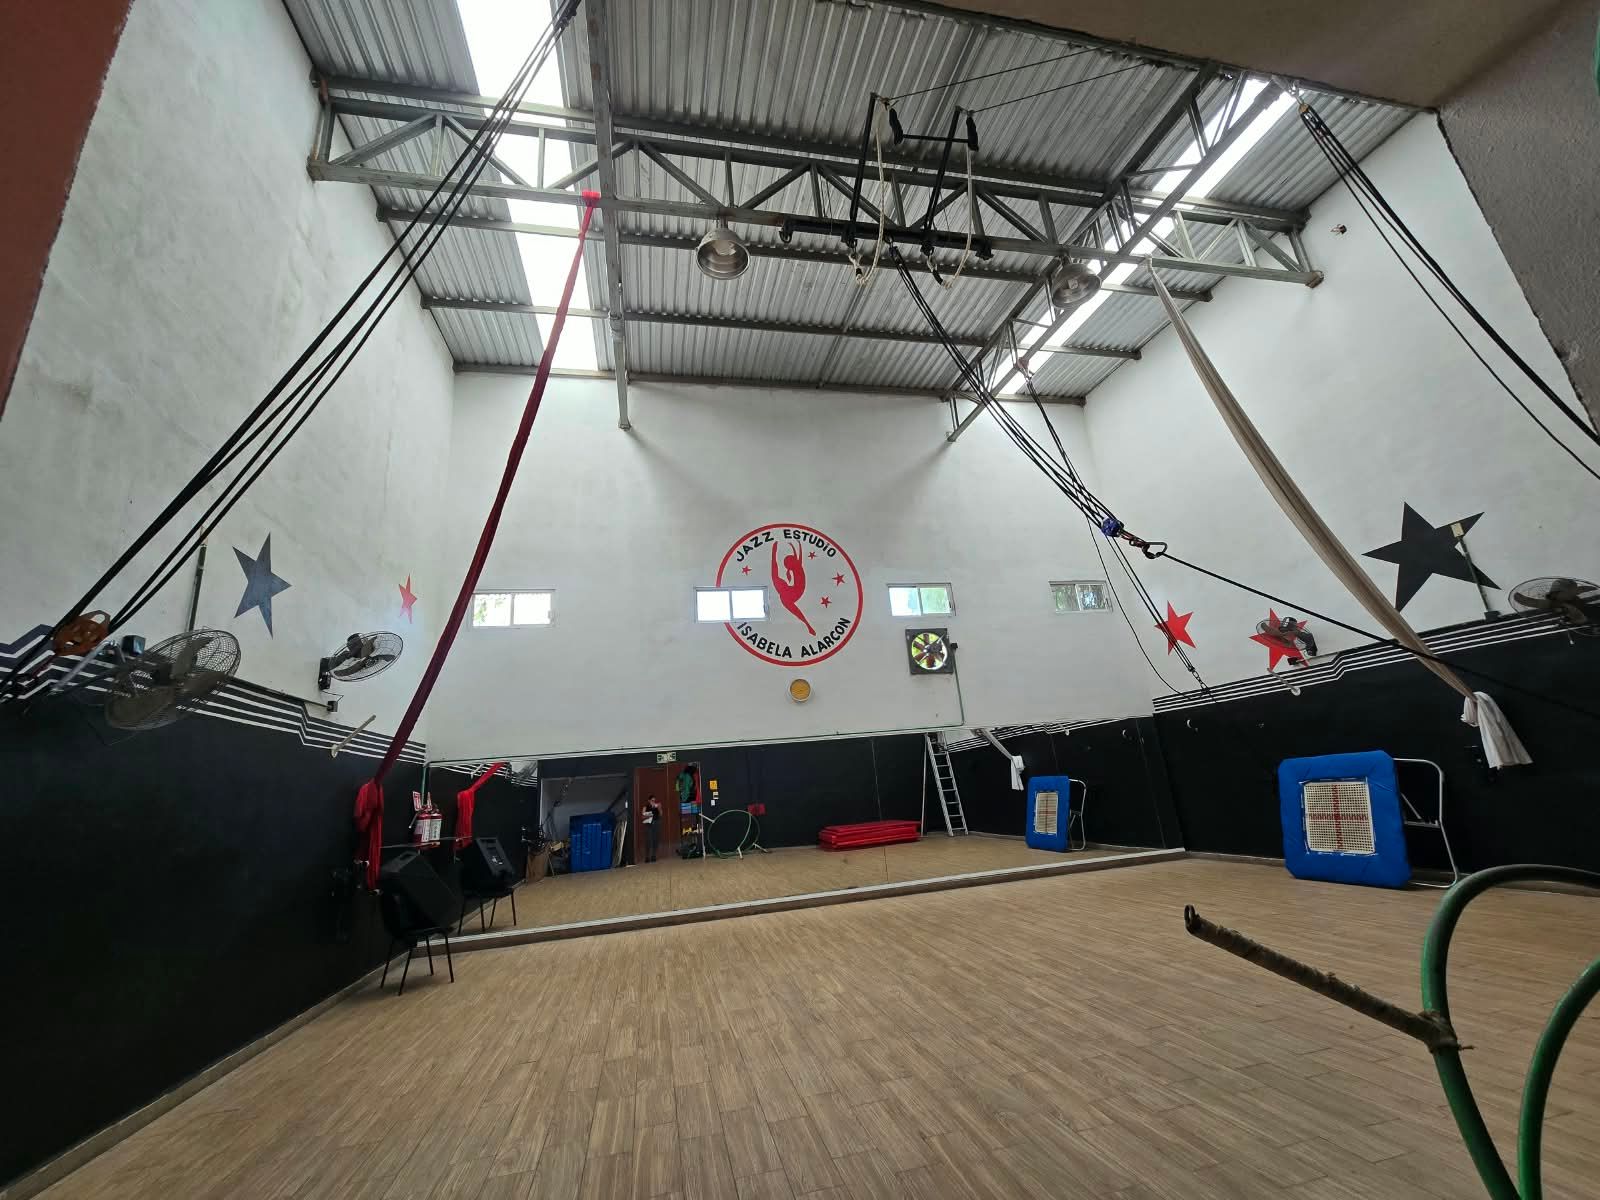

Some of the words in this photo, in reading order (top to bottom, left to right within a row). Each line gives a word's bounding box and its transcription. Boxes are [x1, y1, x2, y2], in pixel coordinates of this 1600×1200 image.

[736, 531, 774, 562] JAZZ
[737, 621, 792, 658] ISABELA
[800, 617, 851, 658] ALARCON
